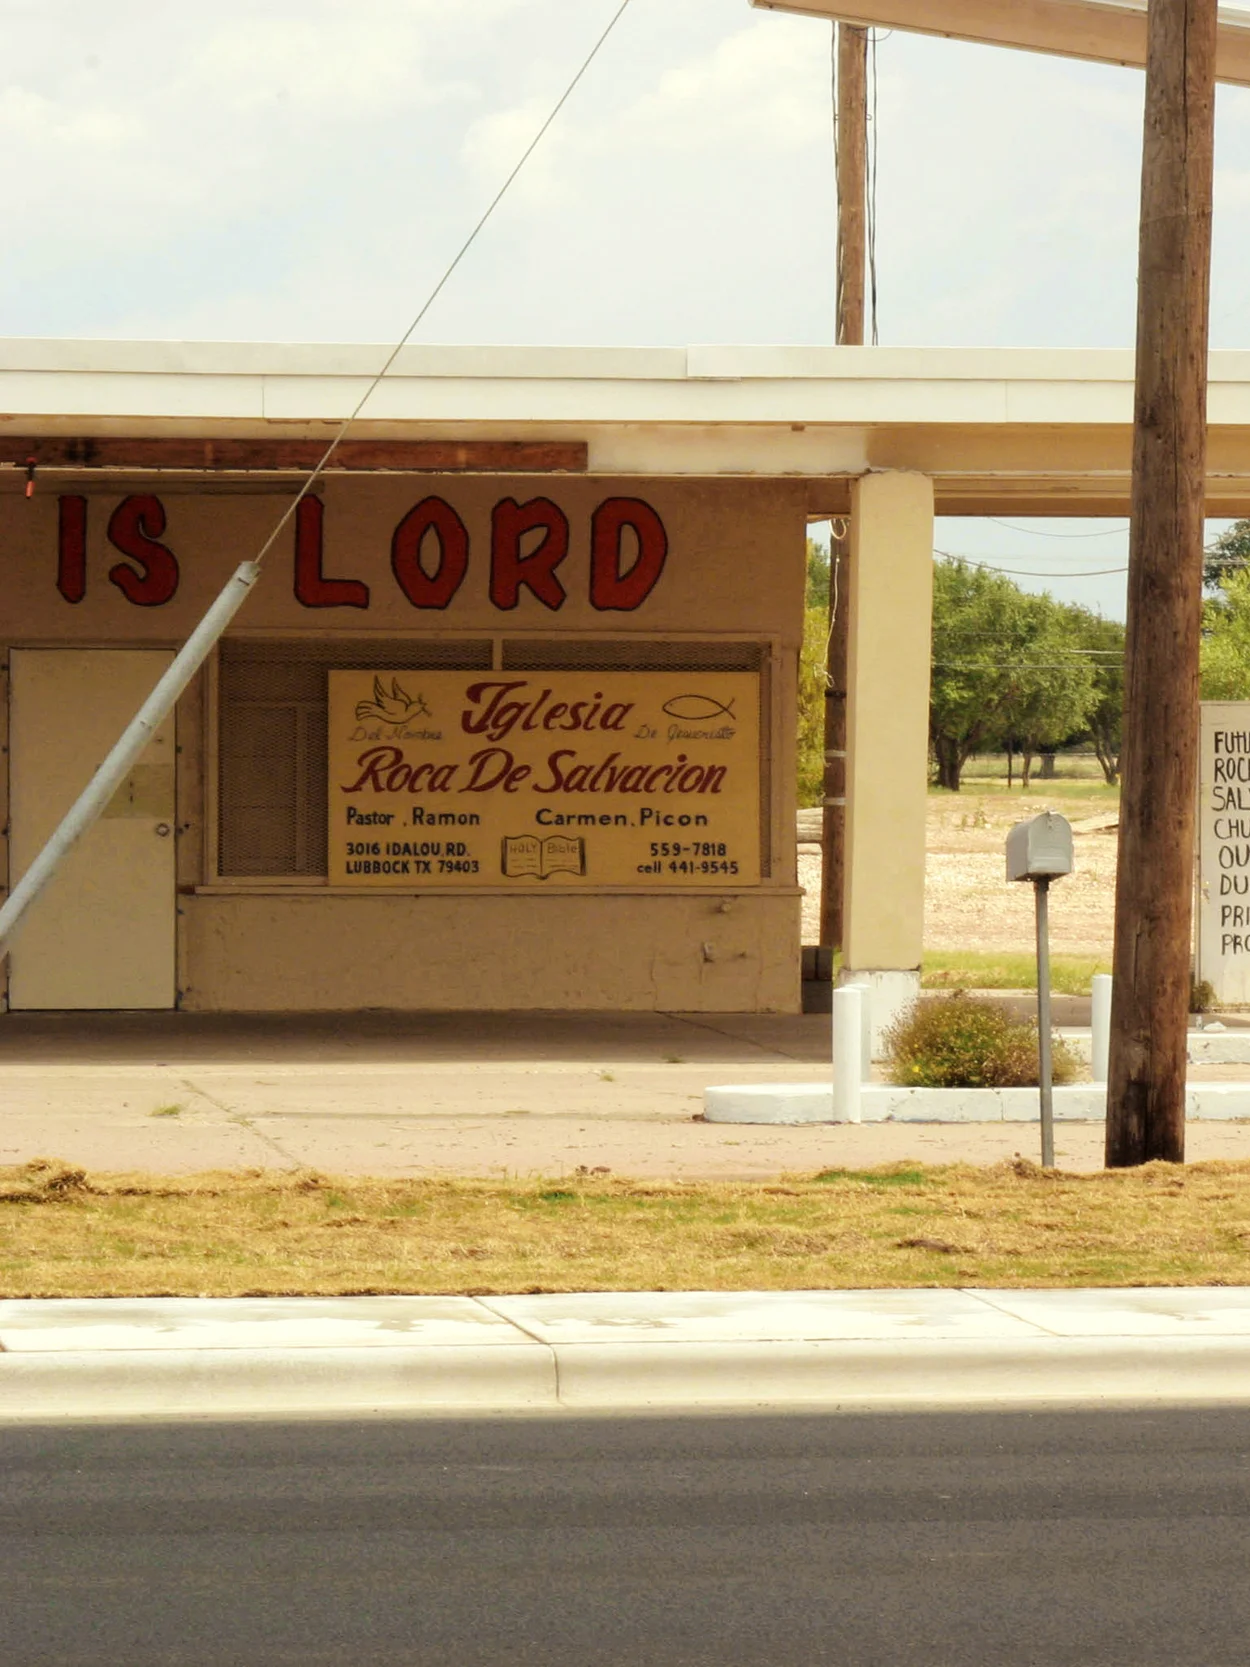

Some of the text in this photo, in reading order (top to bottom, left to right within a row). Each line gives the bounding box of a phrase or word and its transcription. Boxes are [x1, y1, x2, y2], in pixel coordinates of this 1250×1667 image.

[57, 493, 669, 612] IS LORD
[340, 745, 728, 794] Roca De Salvacion
[346, 806, 395, 826] Pastor
[346, 841, 381, 857] 3016
[650, 842, 727, 857] 559-7818
[346, 859, 480, 875] LUBBOCK TX 79403
[636, 860, 739, 875] cell 441-9545
